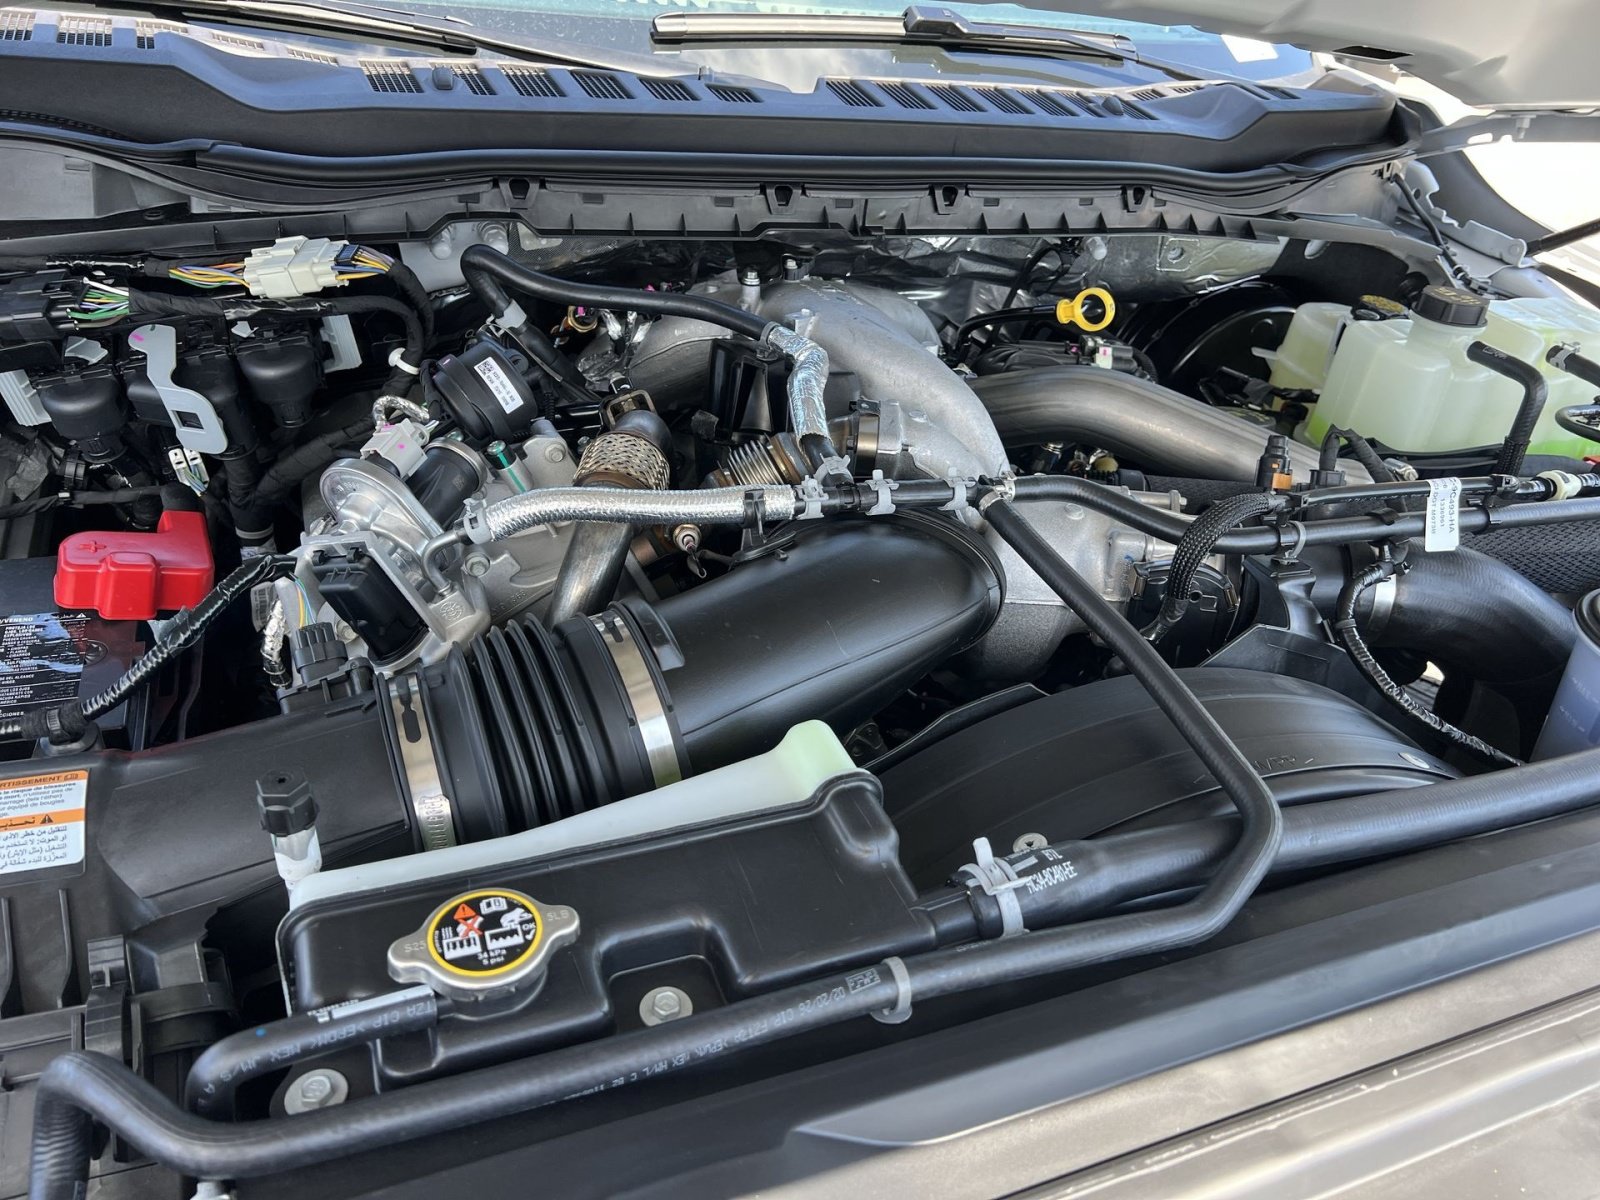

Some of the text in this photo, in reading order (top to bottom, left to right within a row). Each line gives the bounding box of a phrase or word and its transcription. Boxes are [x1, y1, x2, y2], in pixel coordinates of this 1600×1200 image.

[522, 922, 536, 931] OK
[490, 949, 507, 957] kPa
[490, 956, 504, 966] psi
[373, 1010, 400, 1029] CIP
[270, 1045, 302, 1063] MEX
